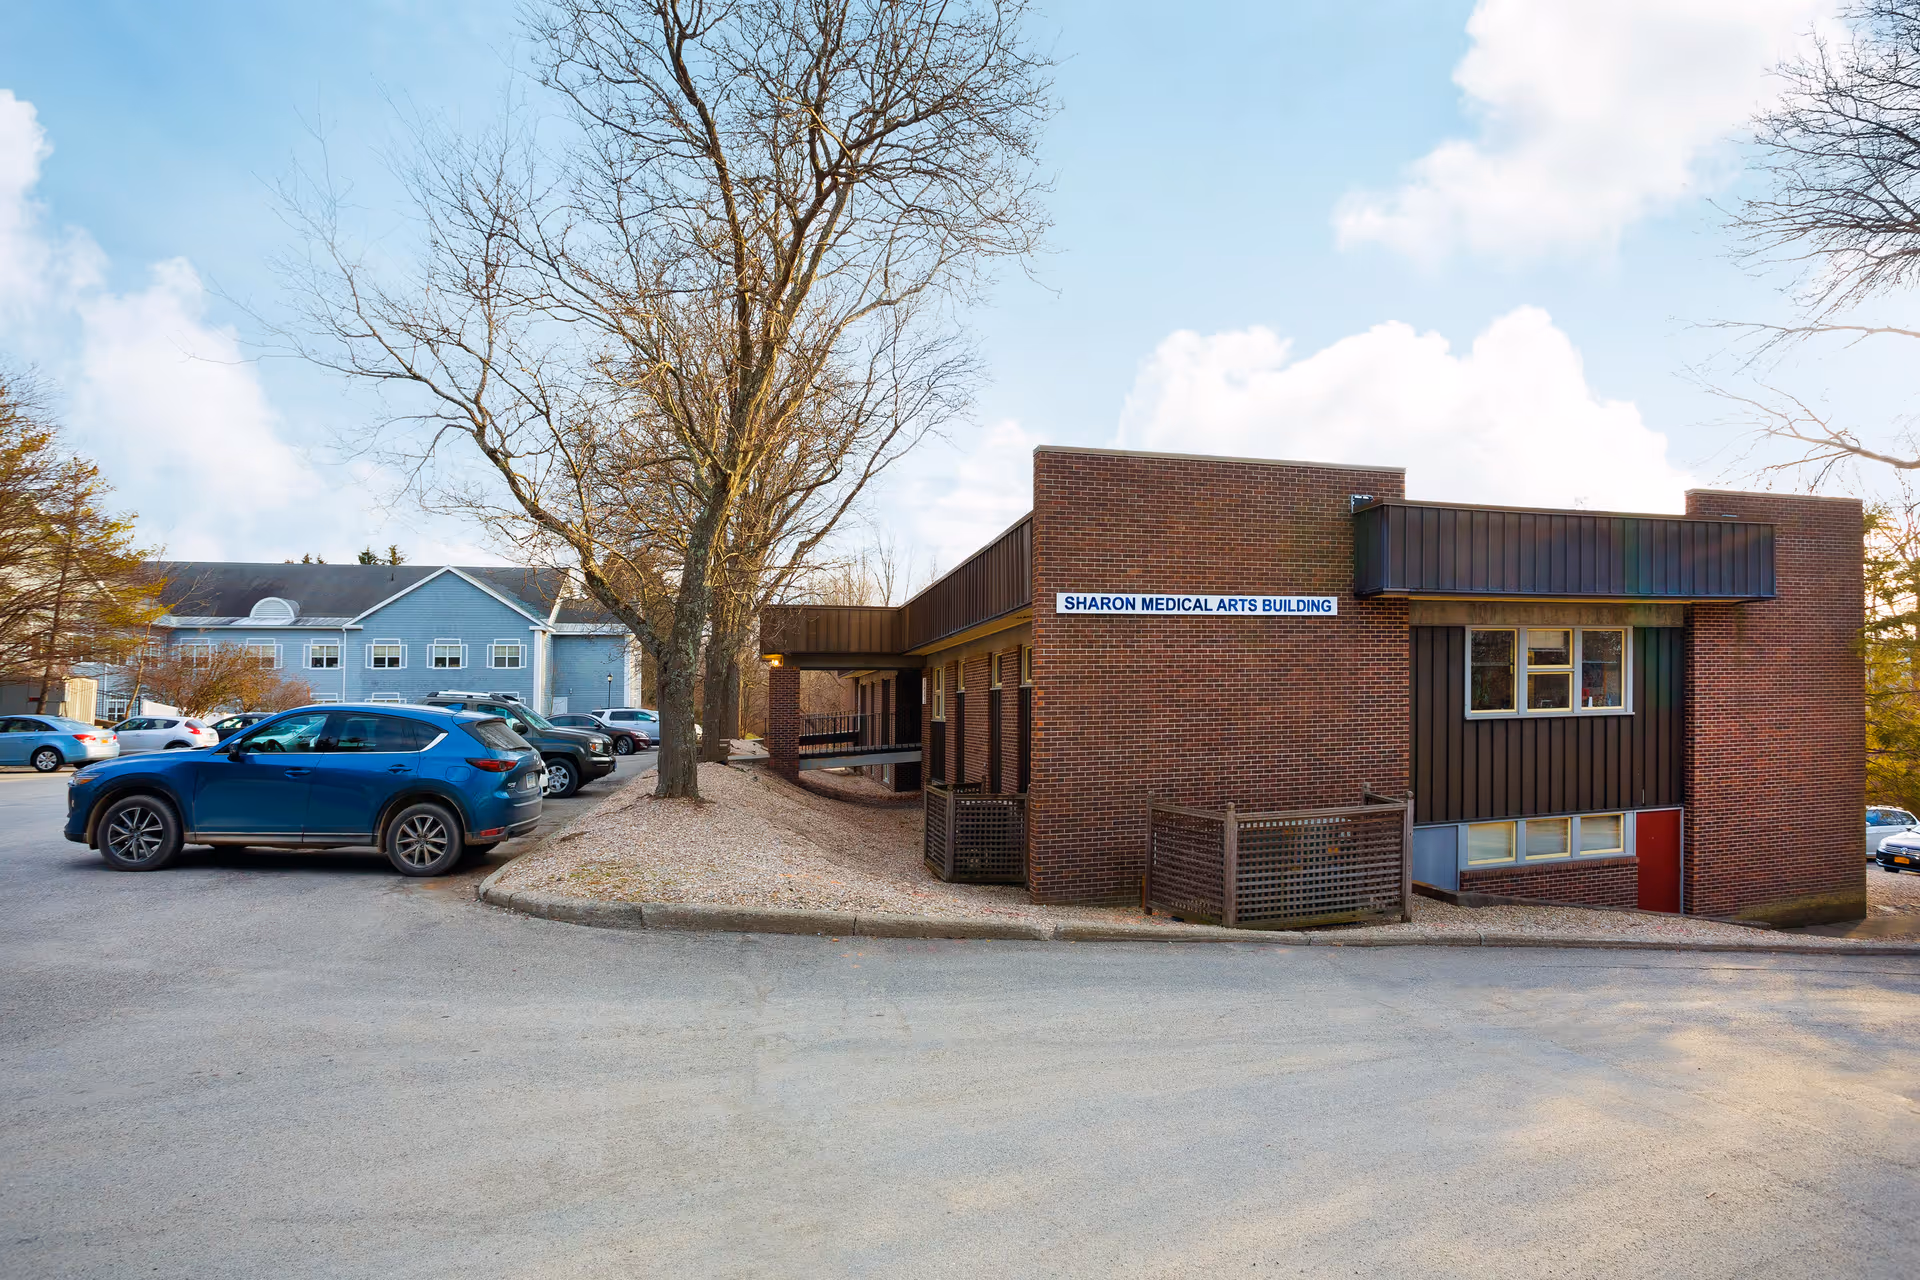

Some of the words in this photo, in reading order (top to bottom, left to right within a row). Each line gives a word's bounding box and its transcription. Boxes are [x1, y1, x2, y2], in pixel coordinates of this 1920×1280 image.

[1064, 596, 1136, 611] SHARON
[1141, 597, 1213, 612] MEDICAL
[1216, 598, 1258, 612] ARTS
[1262, 598, 1332, 613] BUILDING
